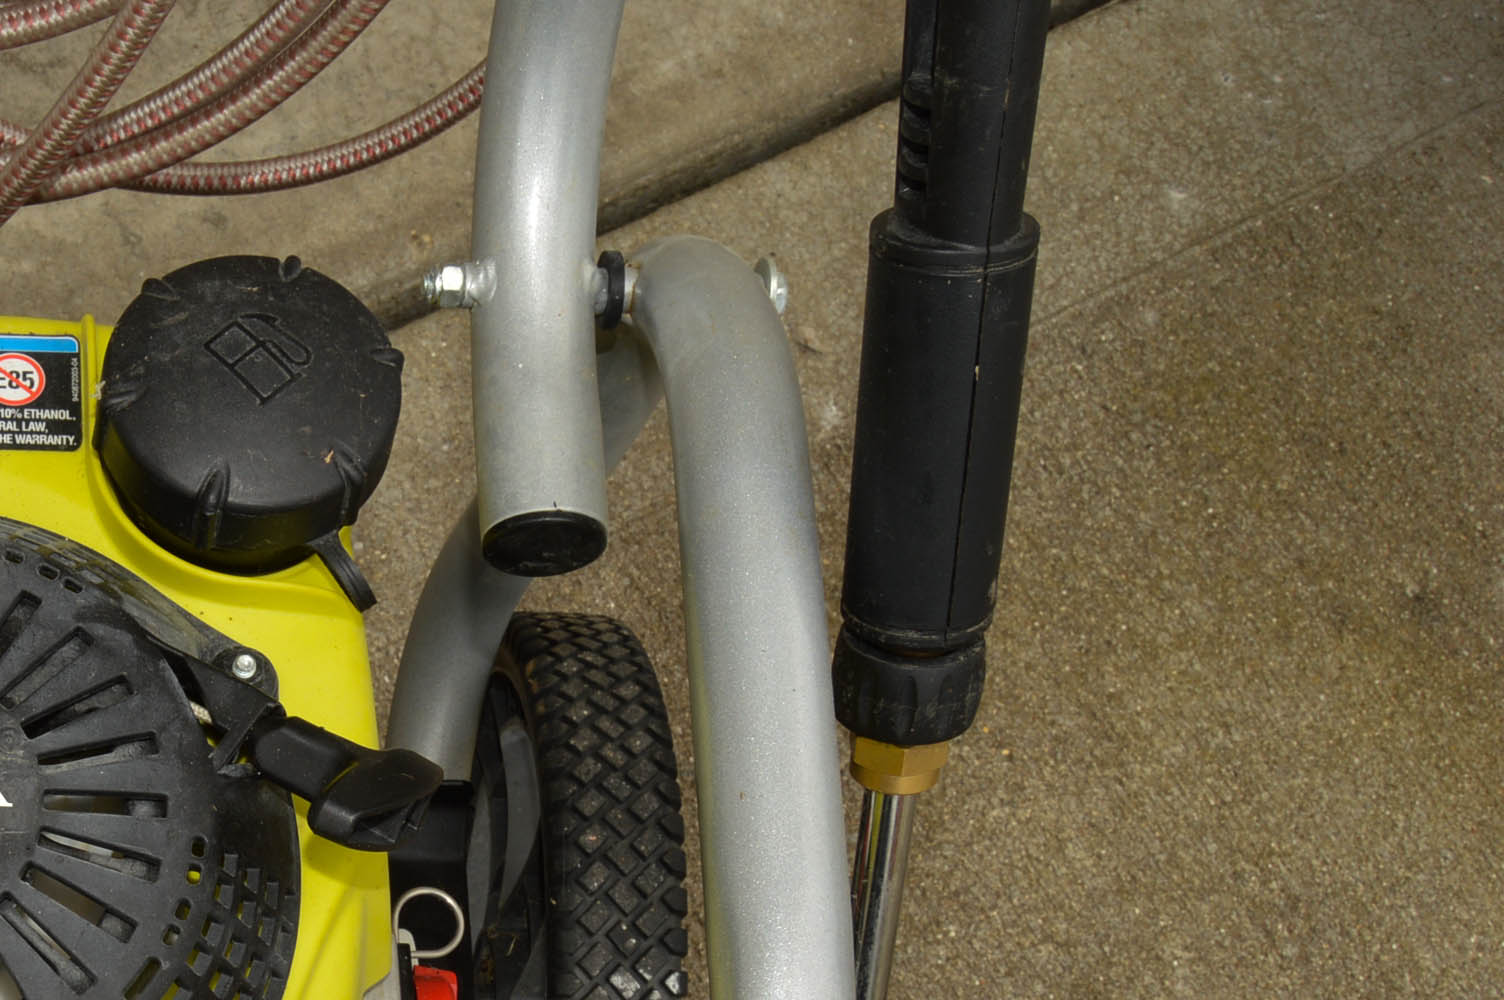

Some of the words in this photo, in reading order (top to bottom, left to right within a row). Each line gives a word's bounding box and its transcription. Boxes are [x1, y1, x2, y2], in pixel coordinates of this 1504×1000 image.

[0, 408, 22, 418] 10%
[24, 409, 76, 420] ETHANOL.
[22, 422, 48, 433] LAW,
[15, 434, 76, 446] WARRANTY.
